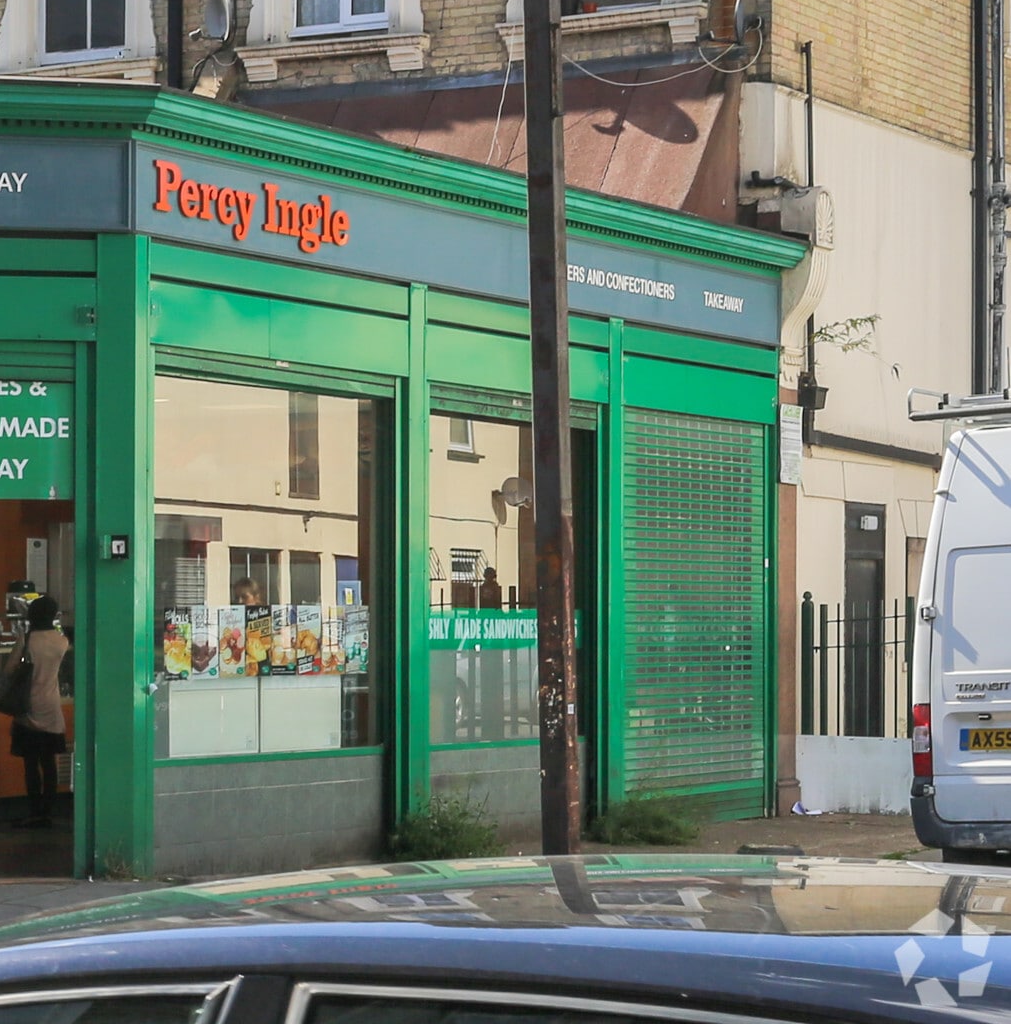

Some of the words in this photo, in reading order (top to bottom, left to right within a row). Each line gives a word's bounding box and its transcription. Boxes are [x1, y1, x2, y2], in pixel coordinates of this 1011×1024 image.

[153, 159, 258, 241] Percy
[262, 182, 351, 254] Ingle
[567, 264, 585, 283] ERS
[587, 269, 605, 287] AND
[606, 272, 675, 300] CONFECTIONERS
[703, 291, 744, 312] TAKEAWAY
[429, 618, 449, 639] SHLY
[454, 618, 481, 639] MADE
[956, 682, 1010, 692] TRANSIT
